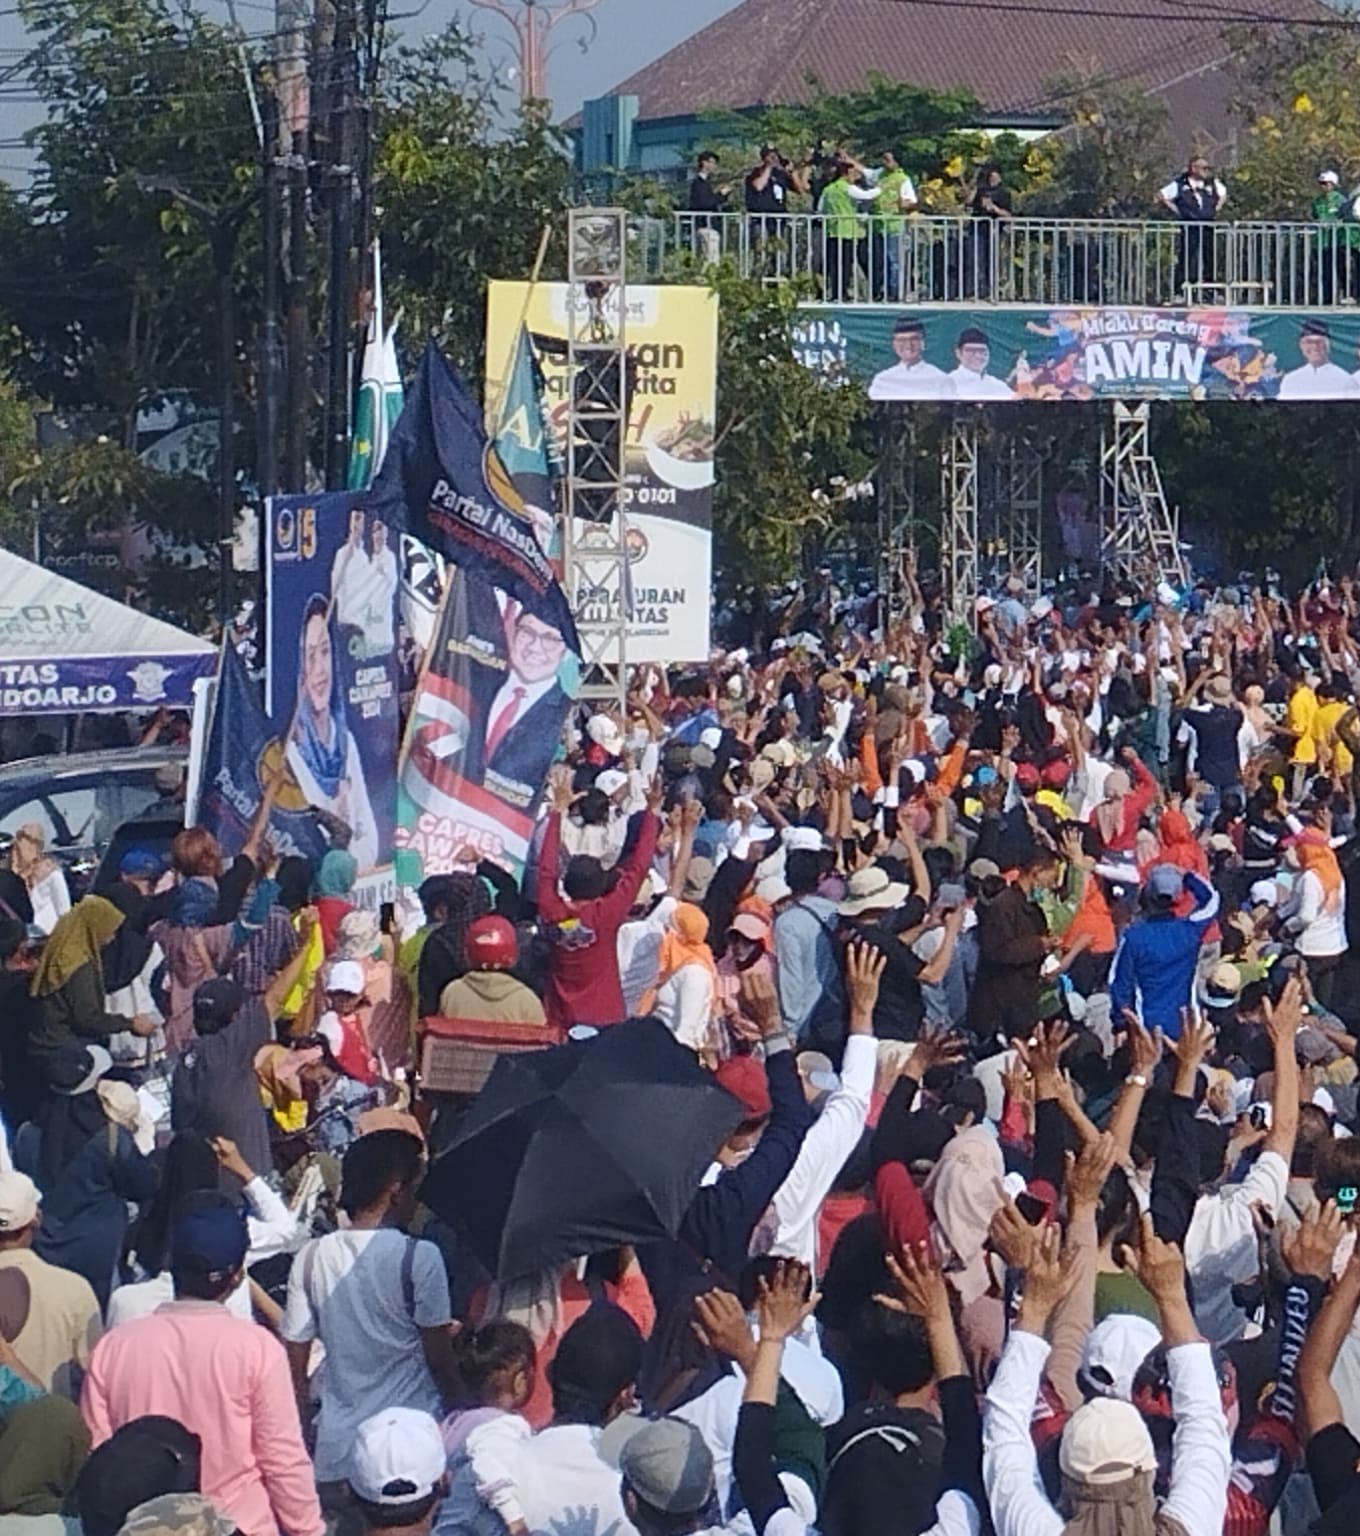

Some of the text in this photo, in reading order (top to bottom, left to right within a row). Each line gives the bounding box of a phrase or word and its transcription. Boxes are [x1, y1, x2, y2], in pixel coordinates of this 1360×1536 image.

[1085, 340, 1207, 385] AMIN
[431, 478, 493, 527] Partai
[576, 587, 686, 605] PERAURAN
[3, 664, 59, 684] TAS
